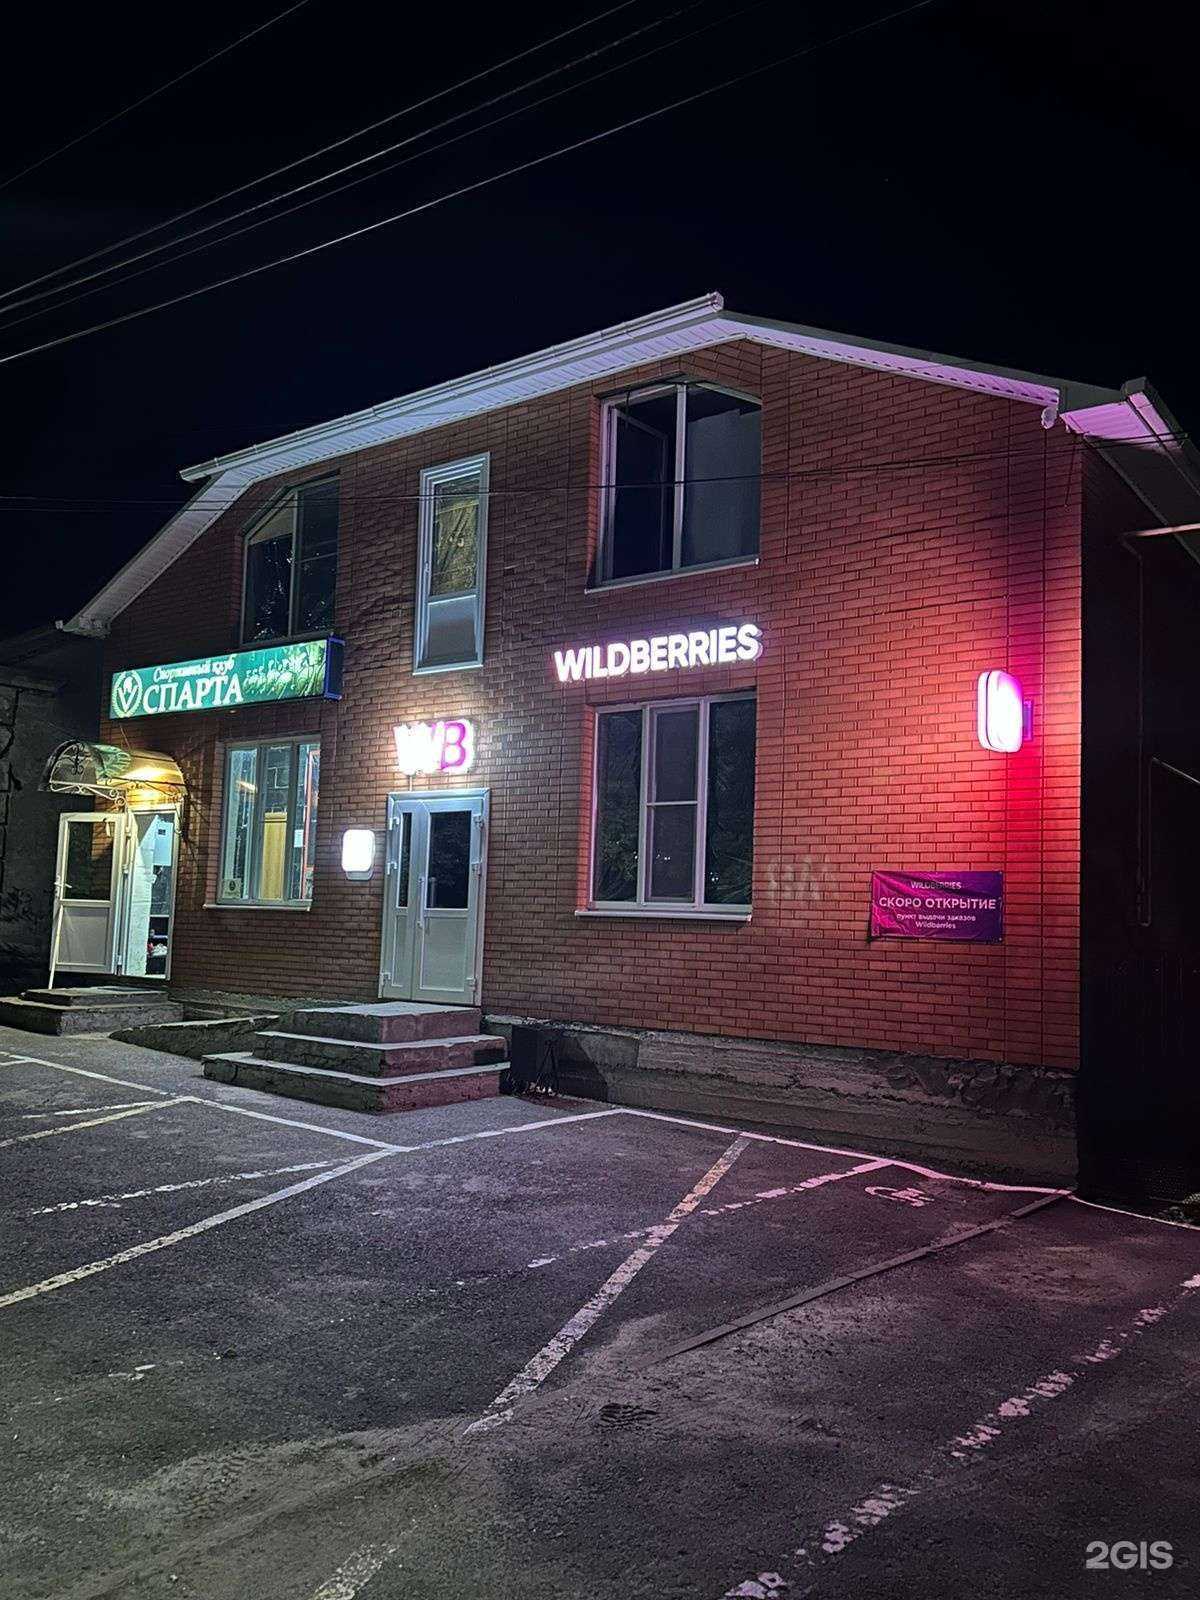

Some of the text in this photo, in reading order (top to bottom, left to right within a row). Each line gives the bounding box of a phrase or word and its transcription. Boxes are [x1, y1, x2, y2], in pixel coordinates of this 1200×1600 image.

[554, 624, 763, 682] WILDBERRIES
[142, 674, 243, 714] СПАРТА
[879, 896, 997, 909] СКОРО ОТКРЫТИЕ
